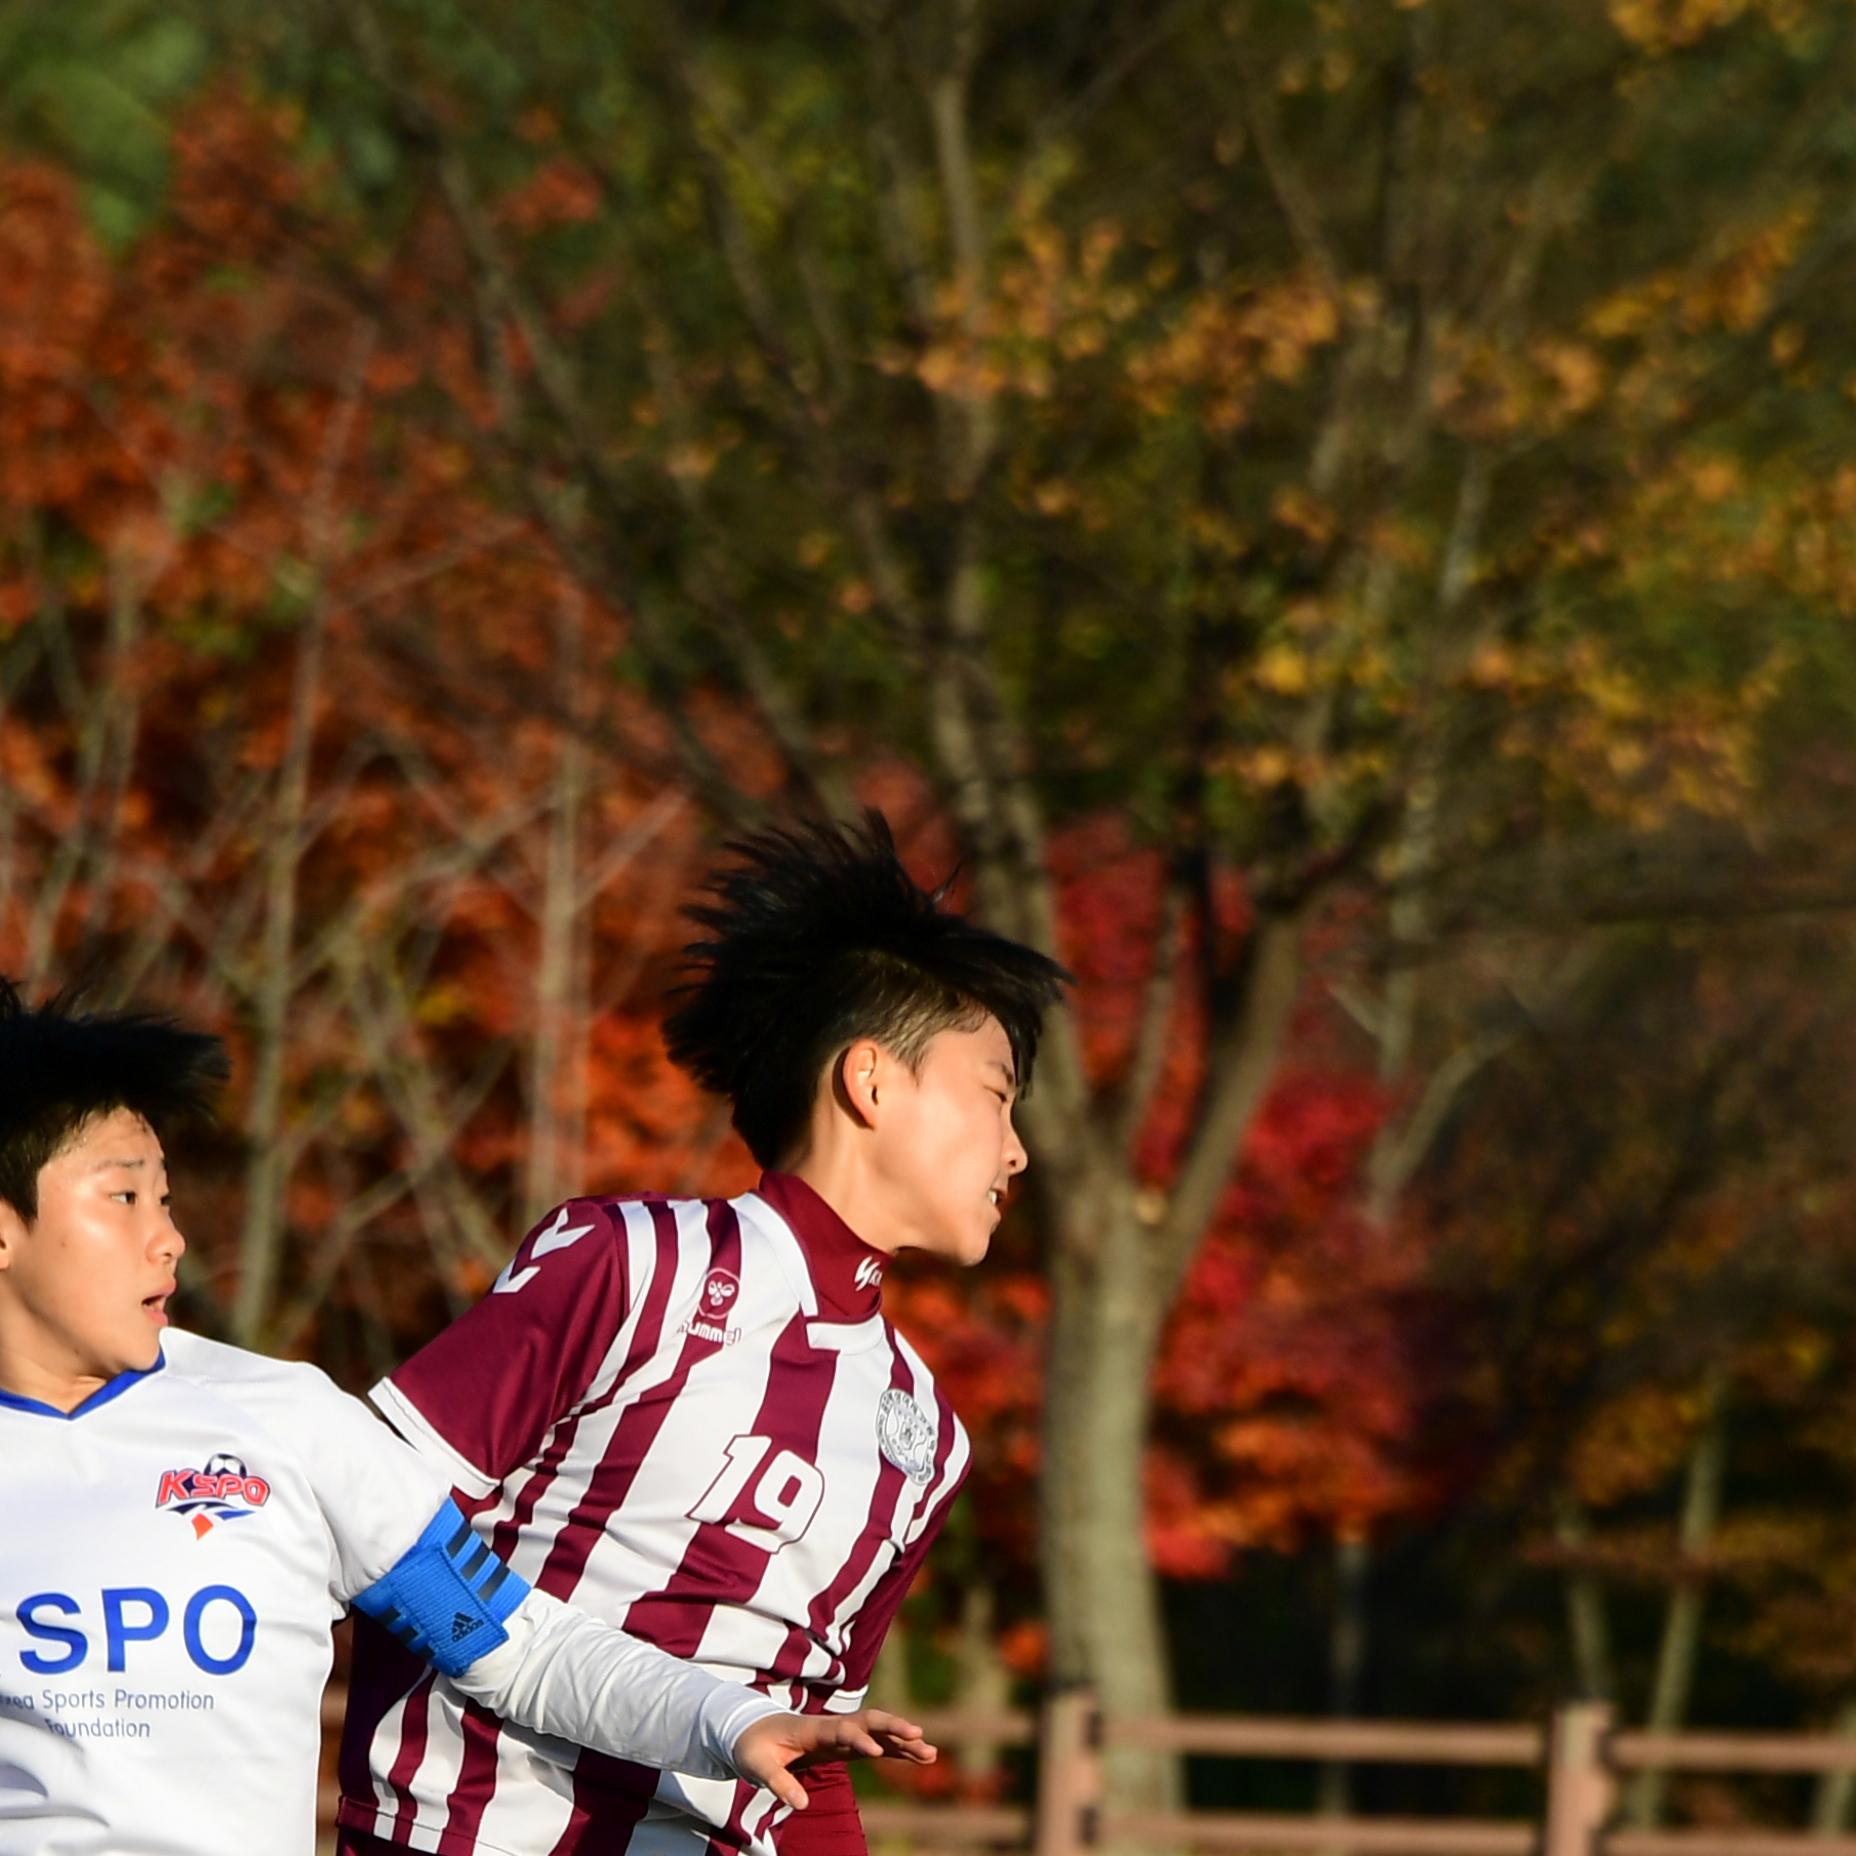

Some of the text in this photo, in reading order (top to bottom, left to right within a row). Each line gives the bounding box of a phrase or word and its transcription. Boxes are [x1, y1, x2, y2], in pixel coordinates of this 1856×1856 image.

[155, 1468, 271, 1508] KSPO
[685, 1434, 825, 1555] 19
[43, 1689, 105, 1713] Sports
[114, 1689, 214, 1709] Promotion
